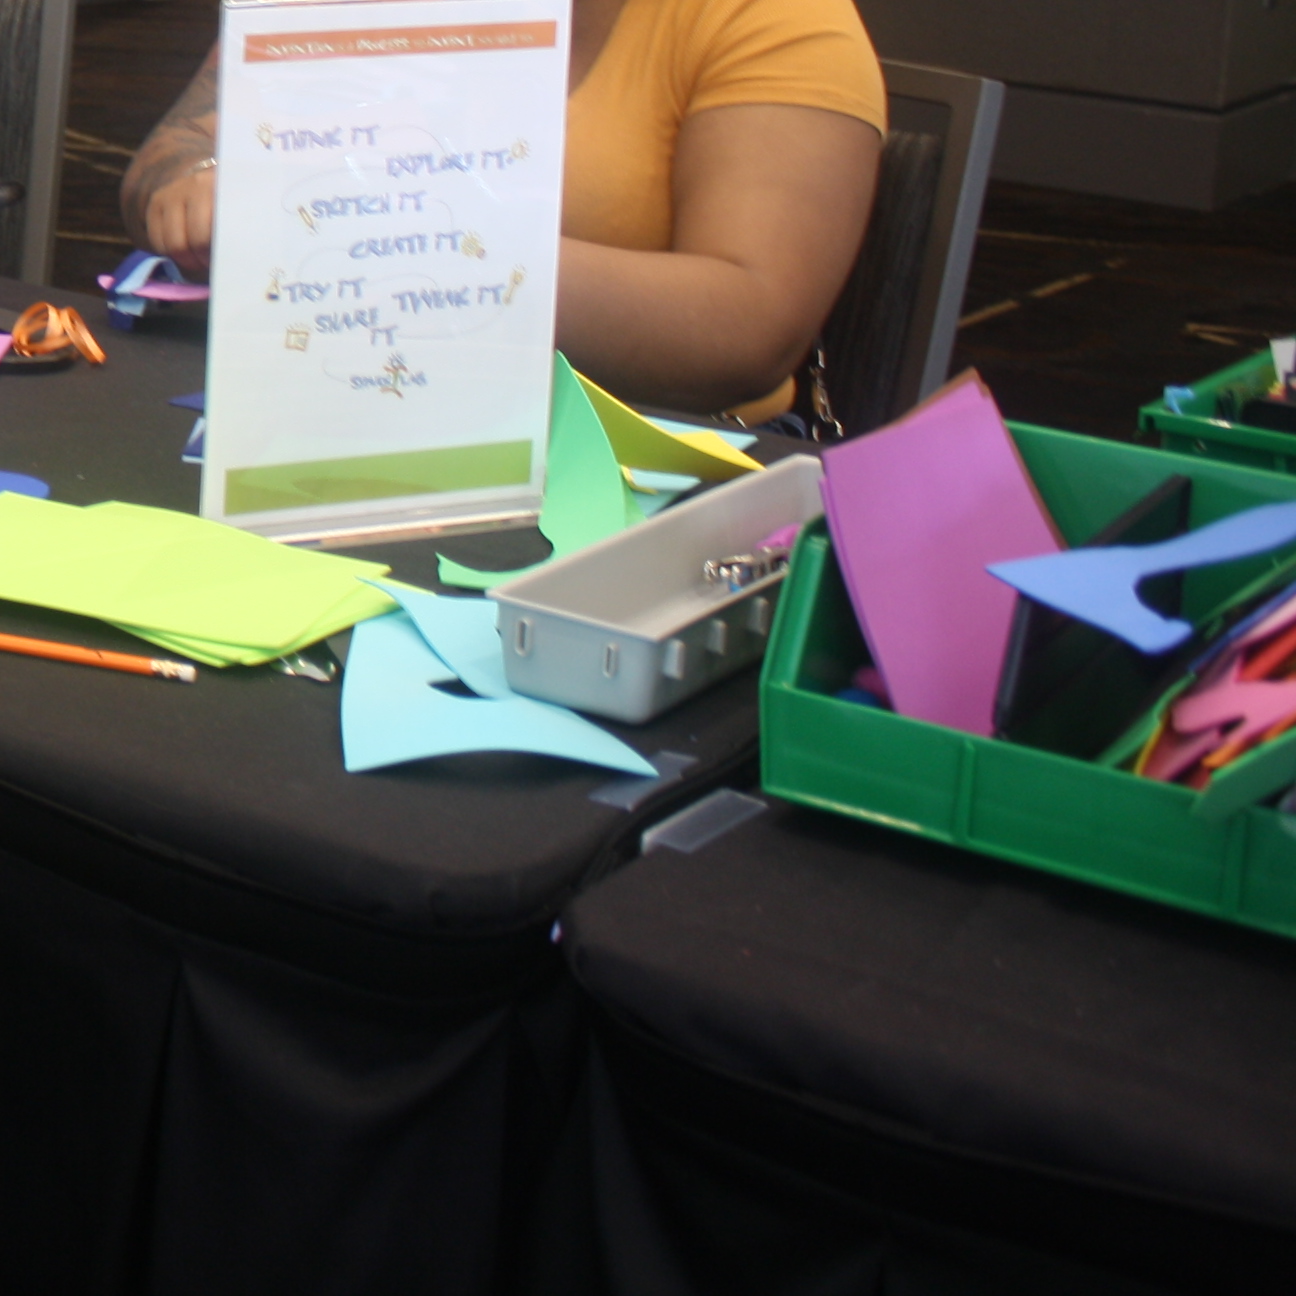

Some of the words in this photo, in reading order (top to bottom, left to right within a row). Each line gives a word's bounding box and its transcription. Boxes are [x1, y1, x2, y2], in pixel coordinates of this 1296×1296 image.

[274, 126, 343, 151] THINK
[349, 124, 380, 146] IT
[385, 151, 475, 178] EXPLORE
[310, 193, 391, 219] SKETCH
[398, 190, 427, 212] IT
[348, 233, 428, 259] CREATE
[435, 230, 464, 251] IT
[283, 281, 332, 304] TRY
[338, 277, 366, 299] IT
[392, 285, 471, 314] TWEAK
[477, 283, 506, 305] IT
[314, 307, 379, 333] SHARE
[370, 324, 398, 346] IT
